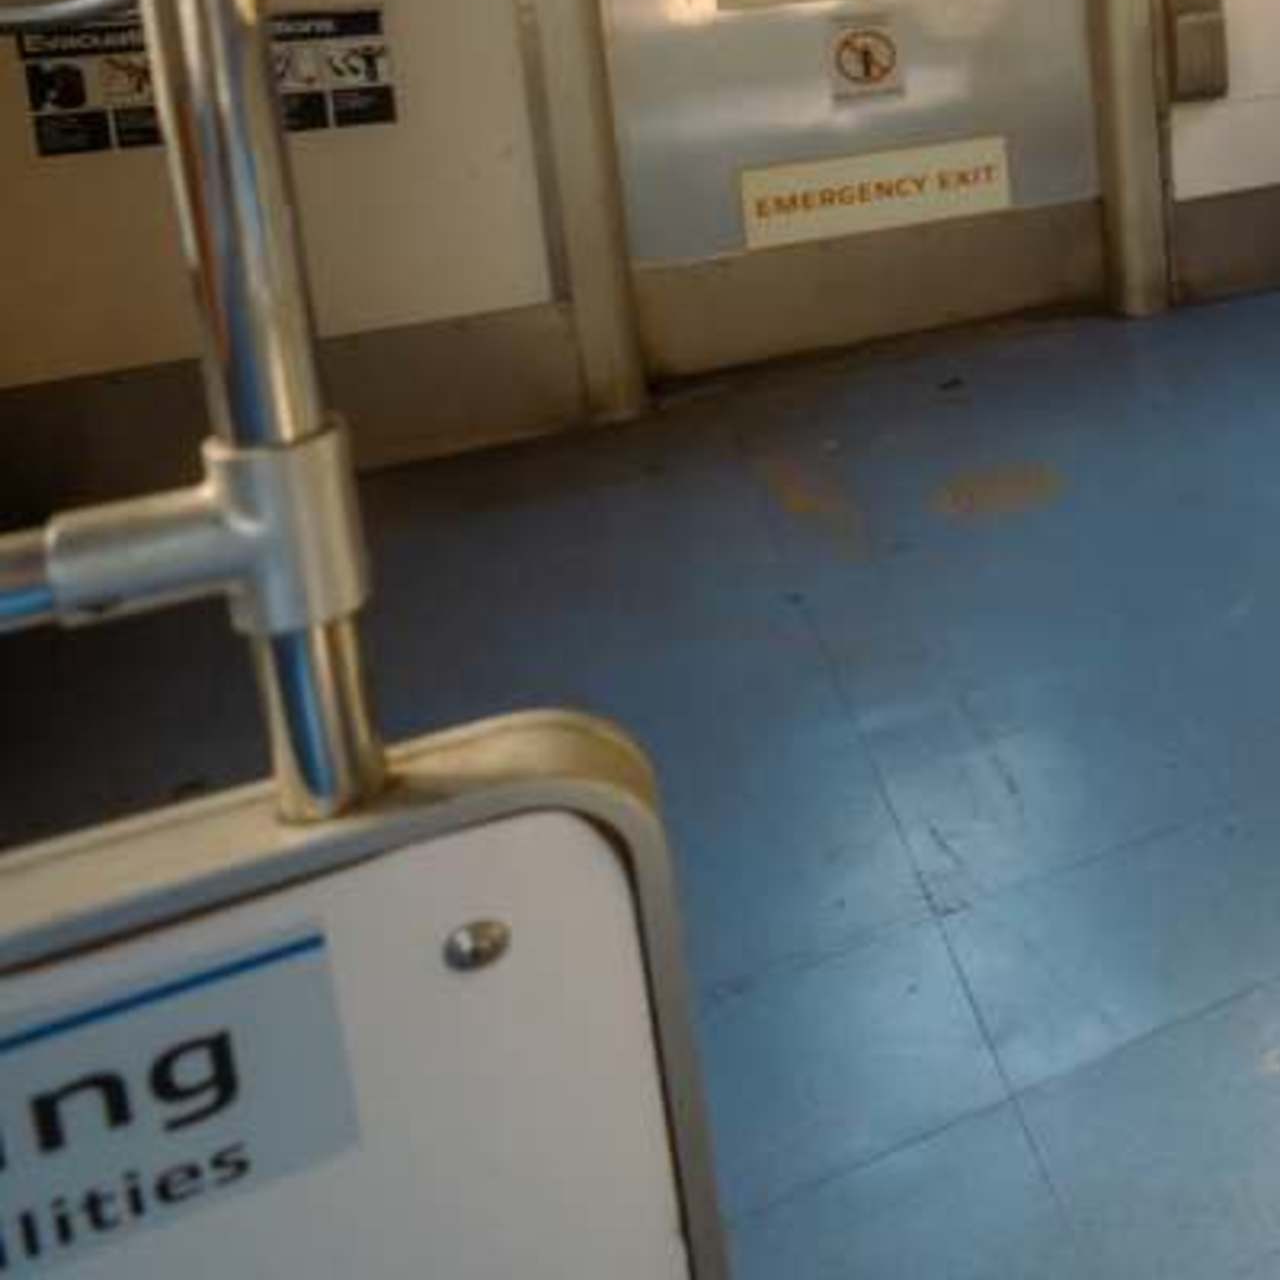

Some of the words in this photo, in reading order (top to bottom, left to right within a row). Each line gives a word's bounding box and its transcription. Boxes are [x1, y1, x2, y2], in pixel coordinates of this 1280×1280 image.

[755, 175, 927, 219] EMERGENCY
[936, 164, 995, 193] EXIT
[0, 1028, 239, 1172] ng
[0, 1140, 251, 1272] lities
